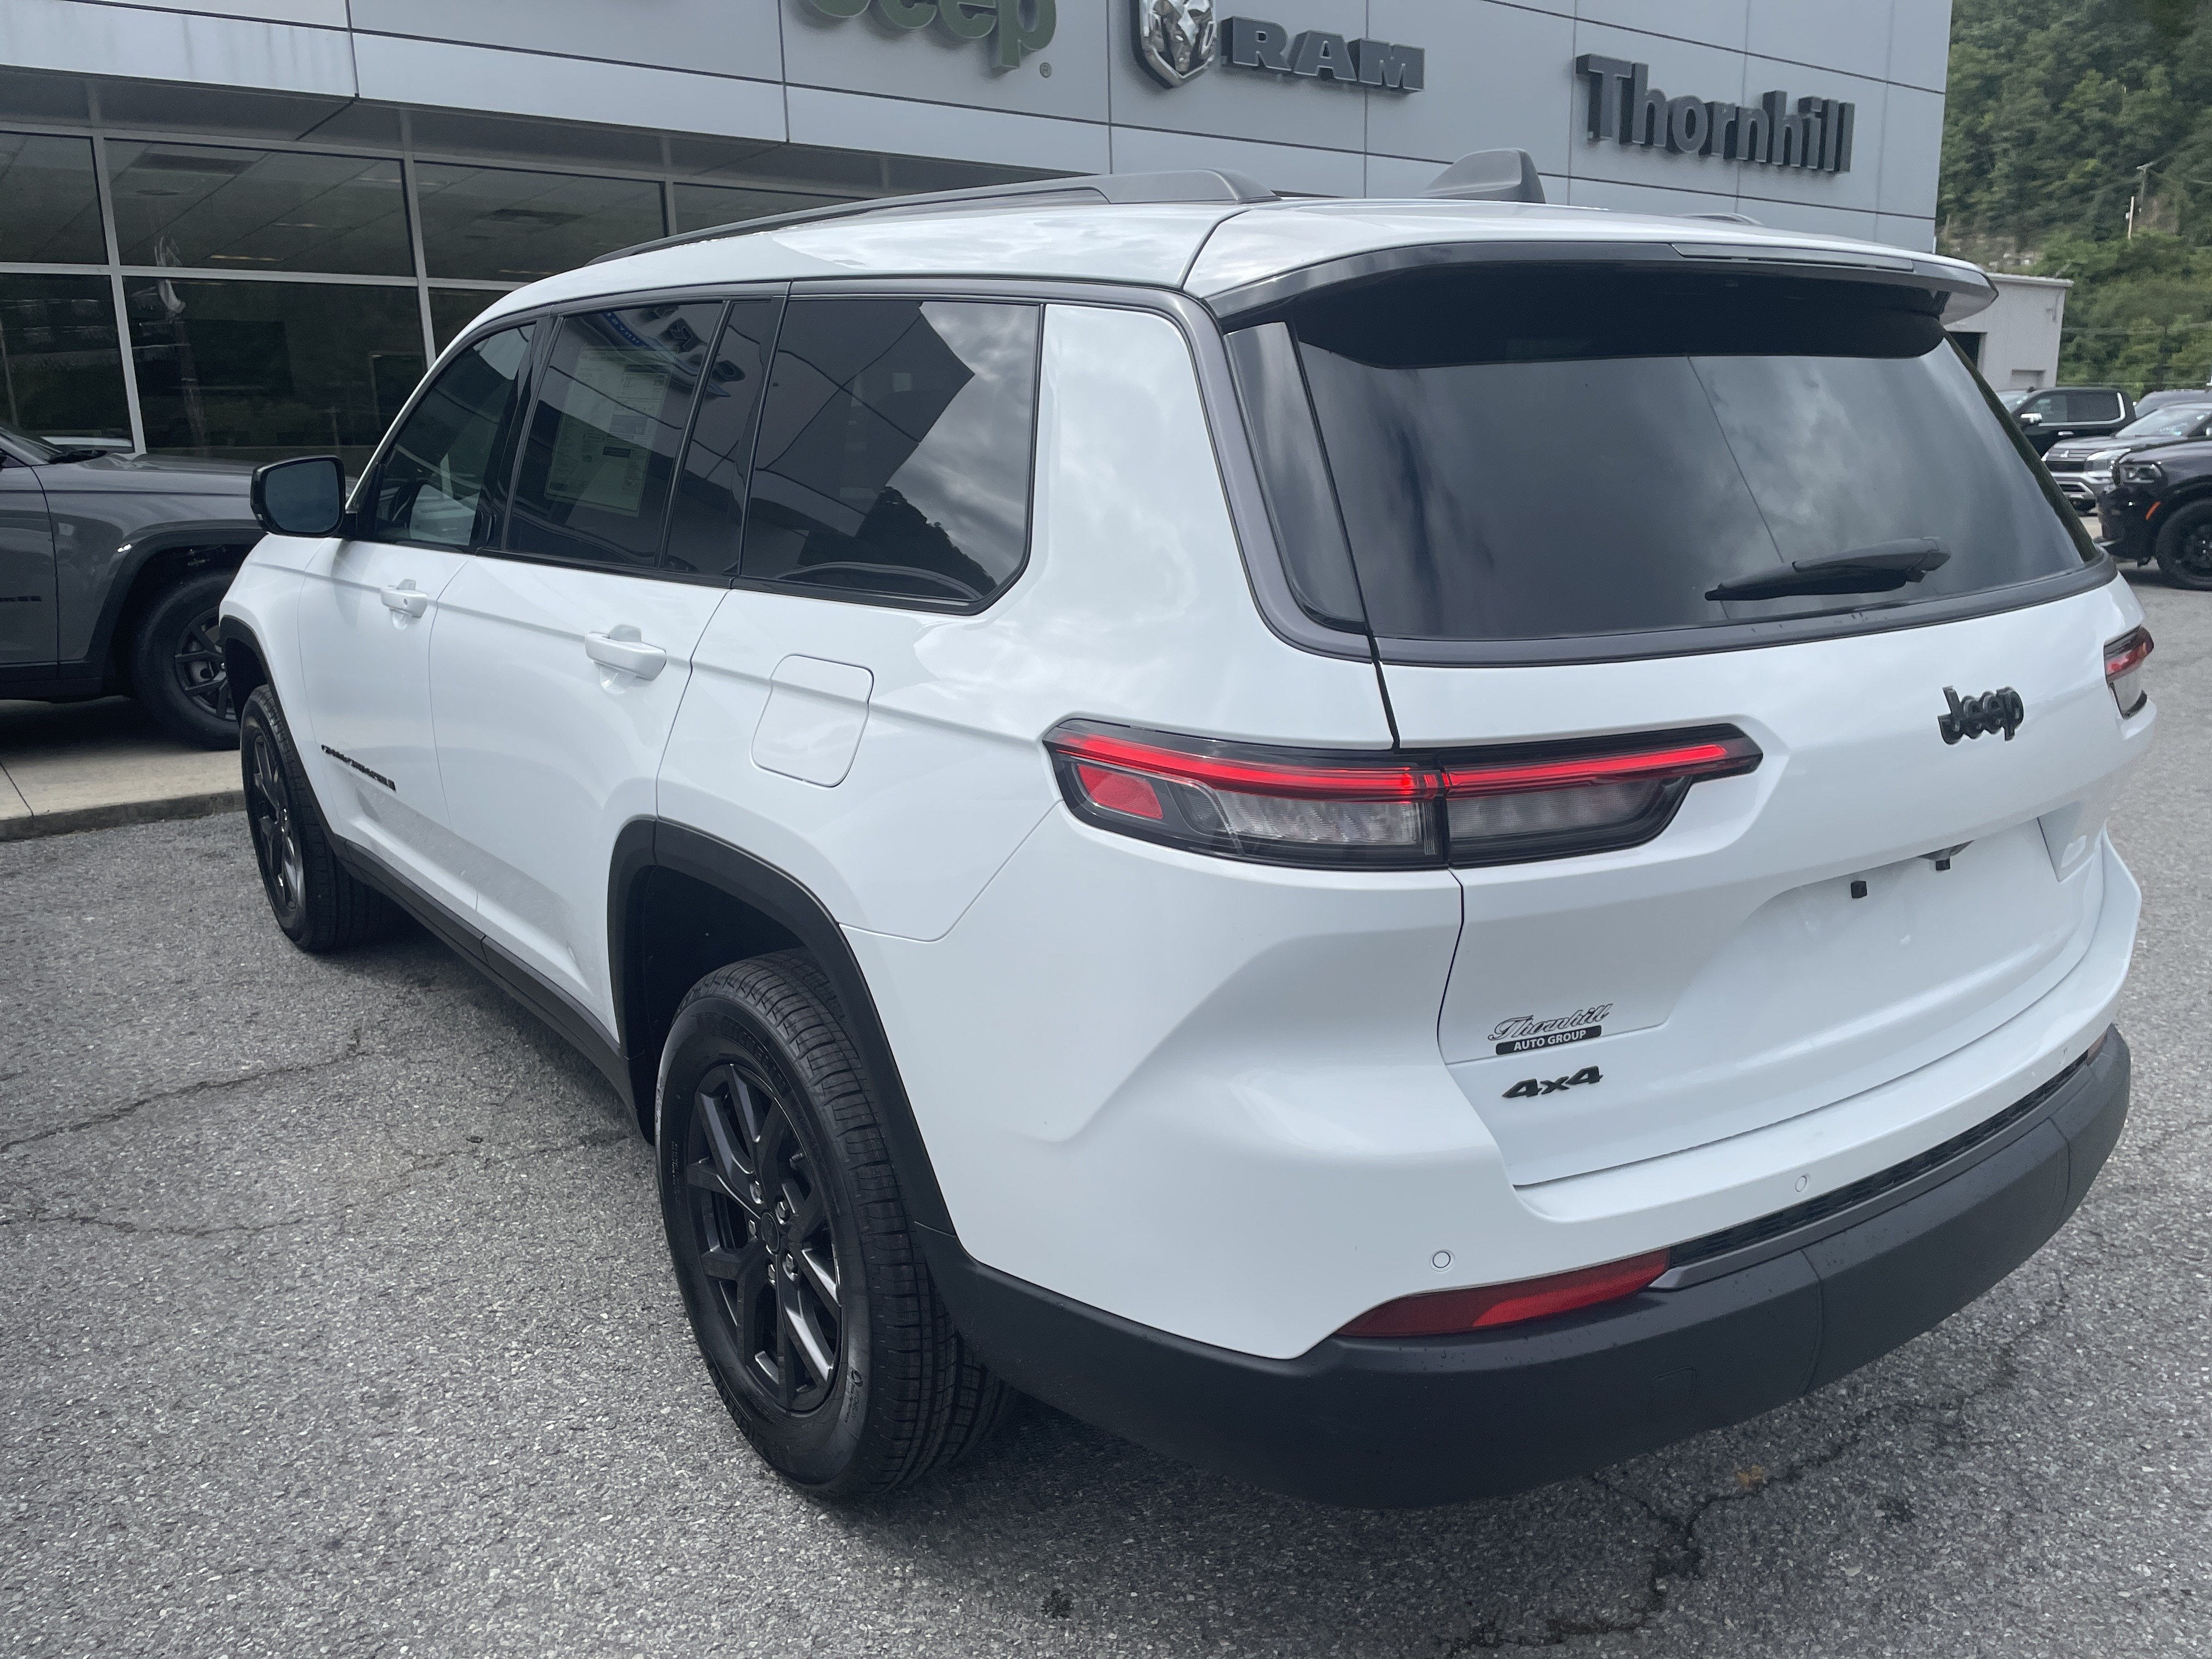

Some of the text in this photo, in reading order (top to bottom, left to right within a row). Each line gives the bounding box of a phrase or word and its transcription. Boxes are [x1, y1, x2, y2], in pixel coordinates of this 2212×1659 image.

[809, 0, 1056, 69] ep
[1221, 15, 1425, 92] RAM
[1576, 53, 1855, 173] Thornhill
[1938, 685, 2024, 745] Jeep
[1487, 1003, 1613, 1041] Thornhill
[1513, 1029, 1587, 1051] AUTO GROUP
[1502, 1065, 1604, 1098] 4x4
